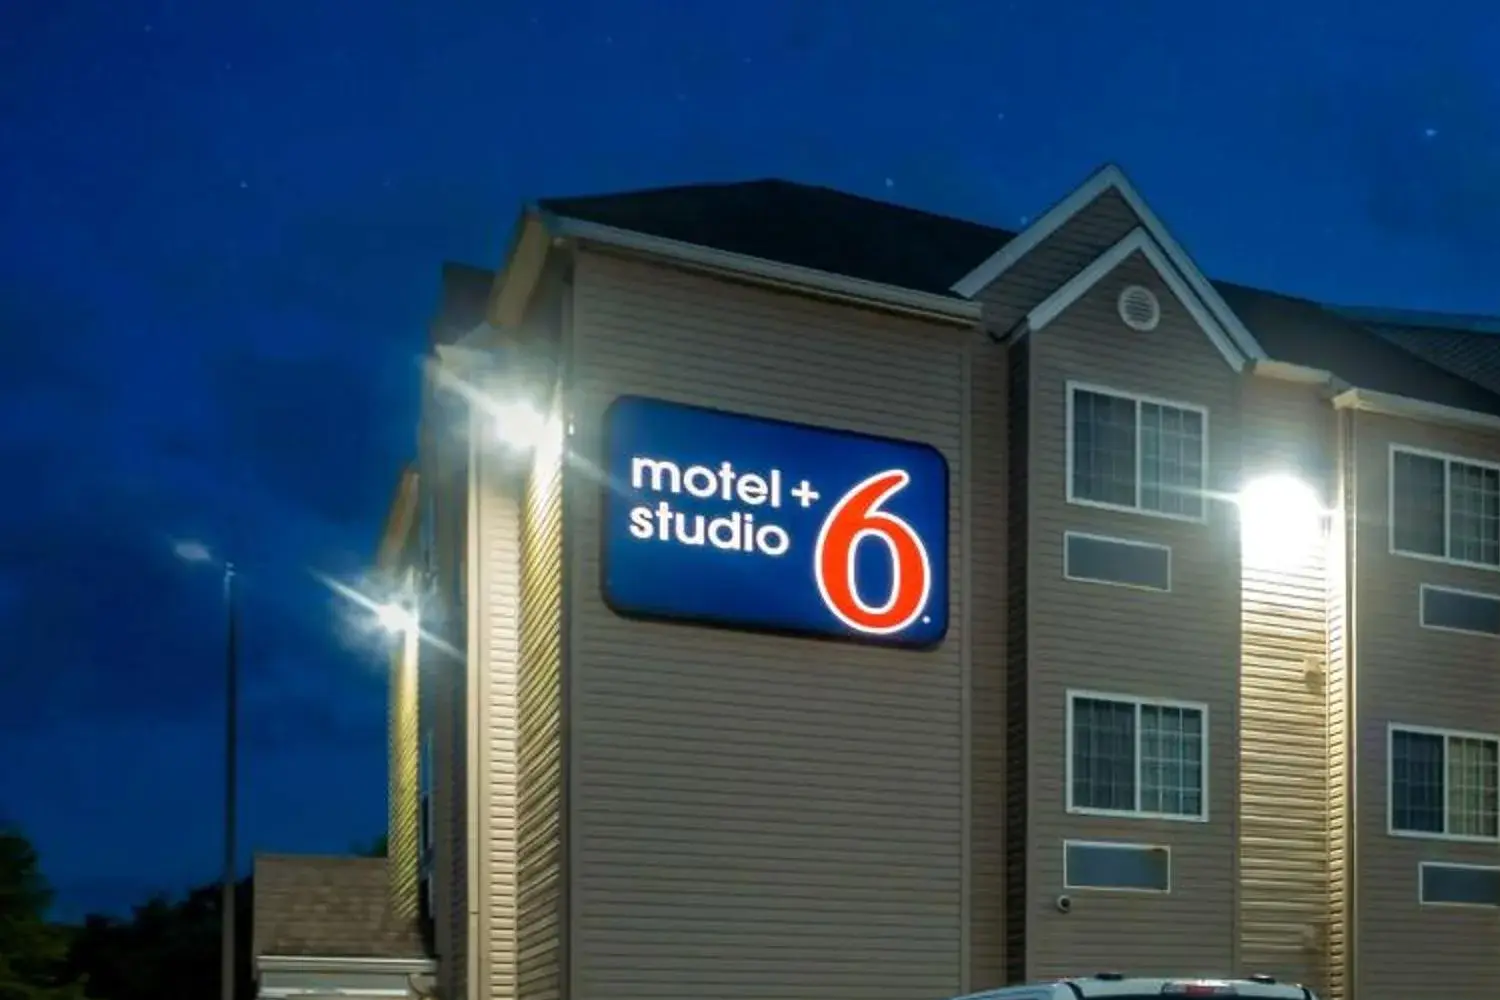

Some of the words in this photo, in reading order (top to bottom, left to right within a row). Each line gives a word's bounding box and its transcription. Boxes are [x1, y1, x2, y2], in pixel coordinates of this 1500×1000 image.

[630, 457, 781, 507] motel
[629, 501, 791, 556] studio
[814, 468, 932, 634] 6
